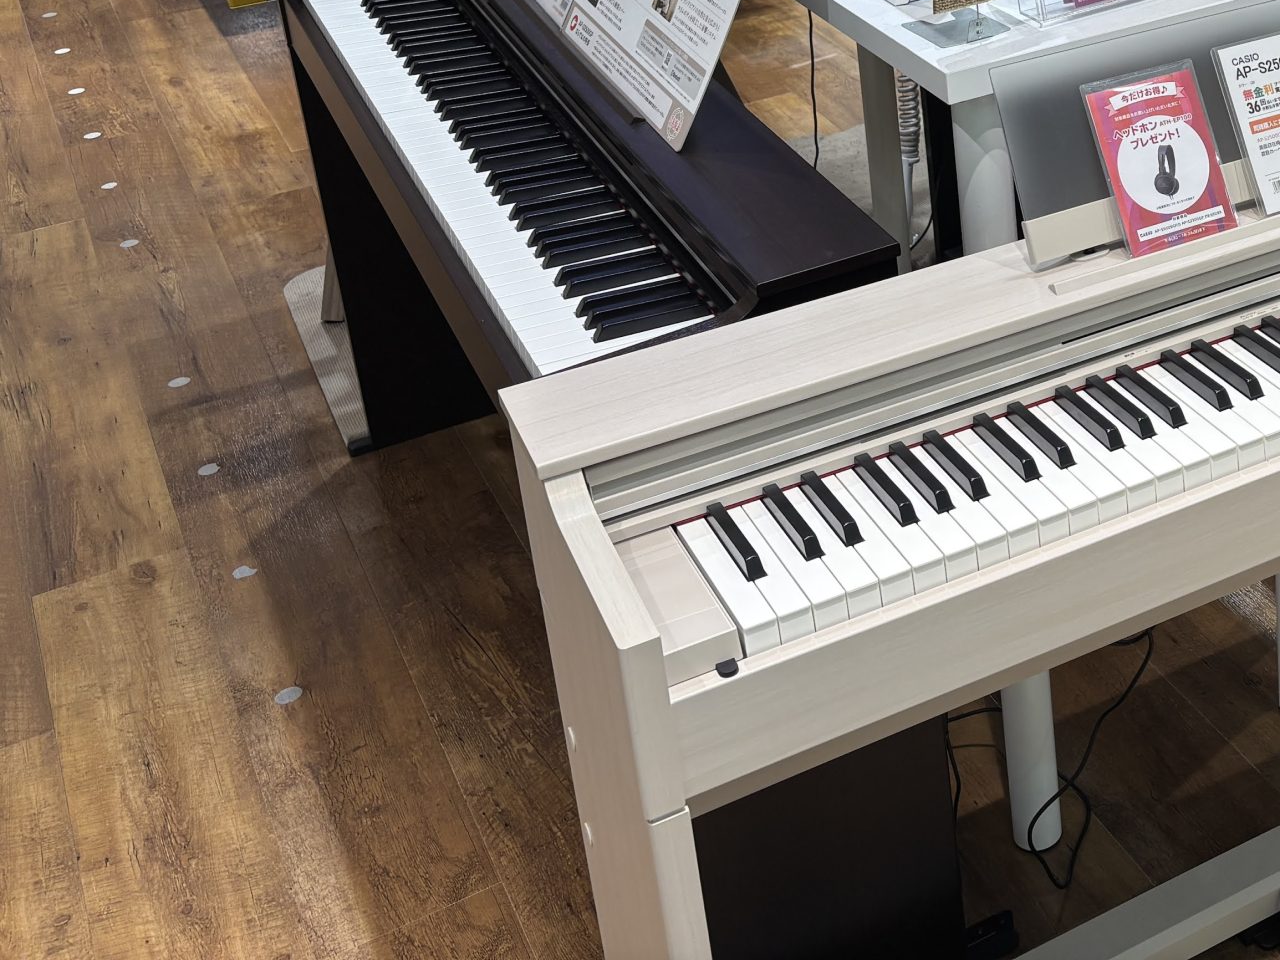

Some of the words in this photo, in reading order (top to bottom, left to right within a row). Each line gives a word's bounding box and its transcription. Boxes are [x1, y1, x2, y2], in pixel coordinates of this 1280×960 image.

[1232, 53, 1259, 66] CASIO
[1243, 81, 1275, 101] 無金利
[1113, 121, 1157, 139] ヘッドホン
[1159, 113, 1192, 127] ATH-EP100
[1130, 129, 1180, 150] プレゼント!
